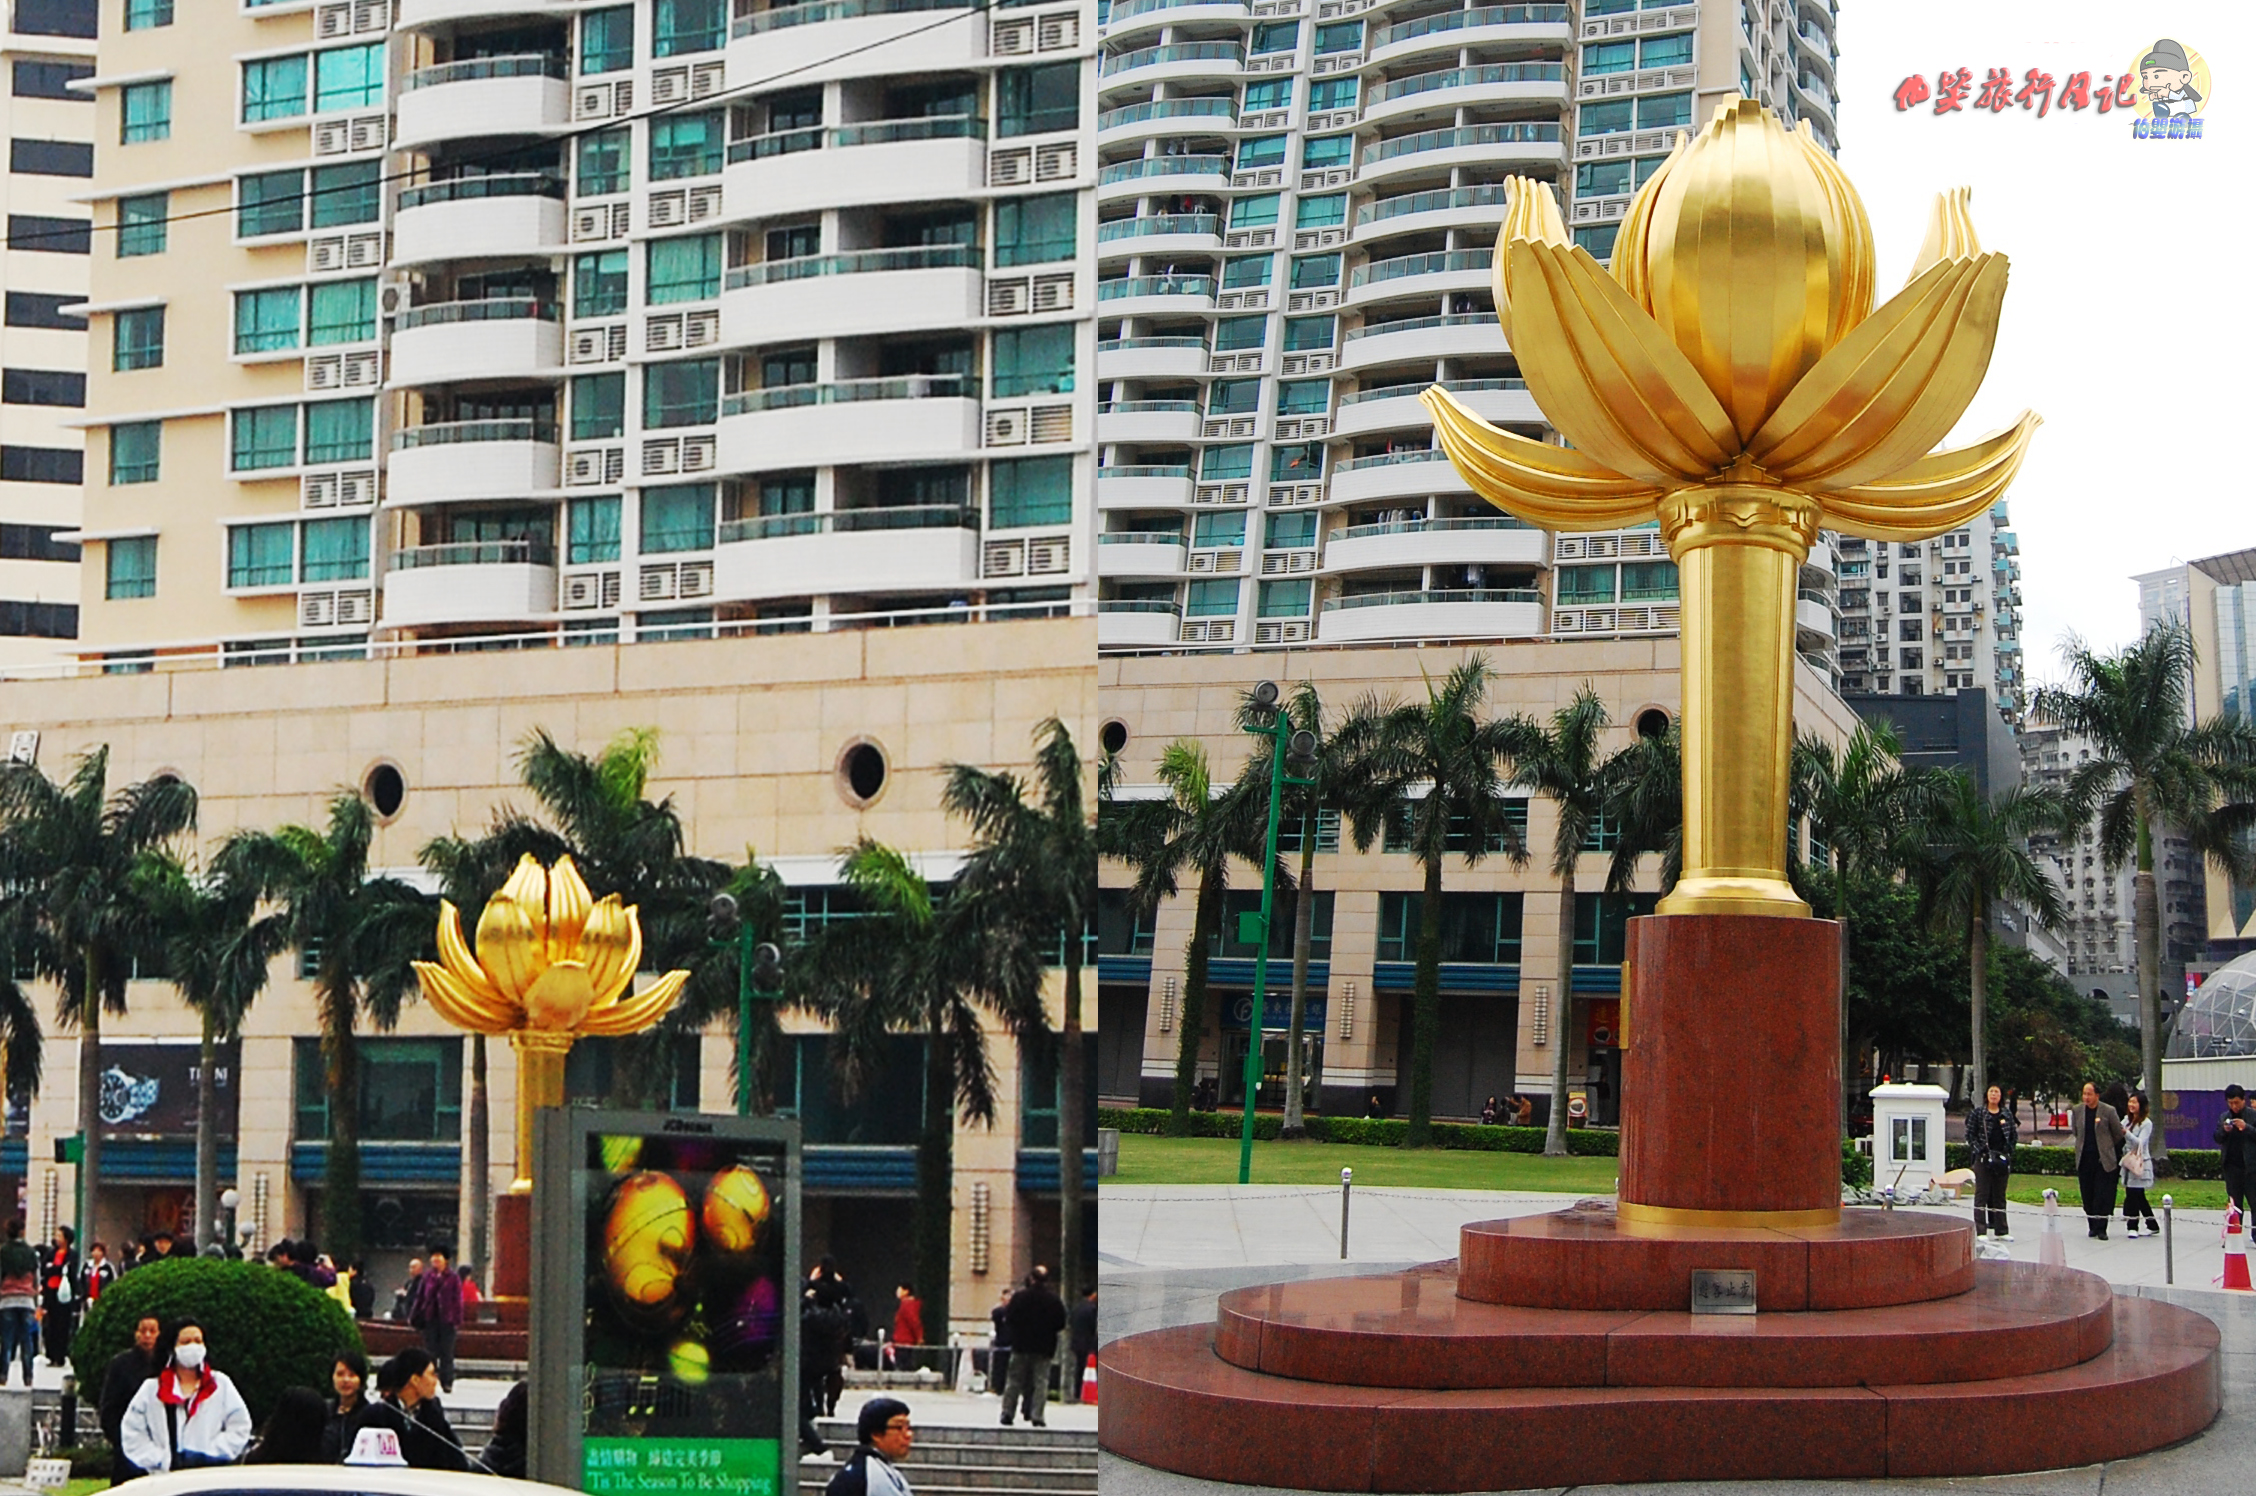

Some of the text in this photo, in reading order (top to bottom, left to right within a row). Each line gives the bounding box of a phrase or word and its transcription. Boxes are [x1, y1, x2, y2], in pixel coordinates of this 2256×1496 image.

[613, 1471, 635, 1489] The
[637, 1471, 677, 1489] Season
[679, 1471, 695, 1489] To
[697, 1472, 713, 1489] Be
[716, 1471, 772, 1495] Shopping
